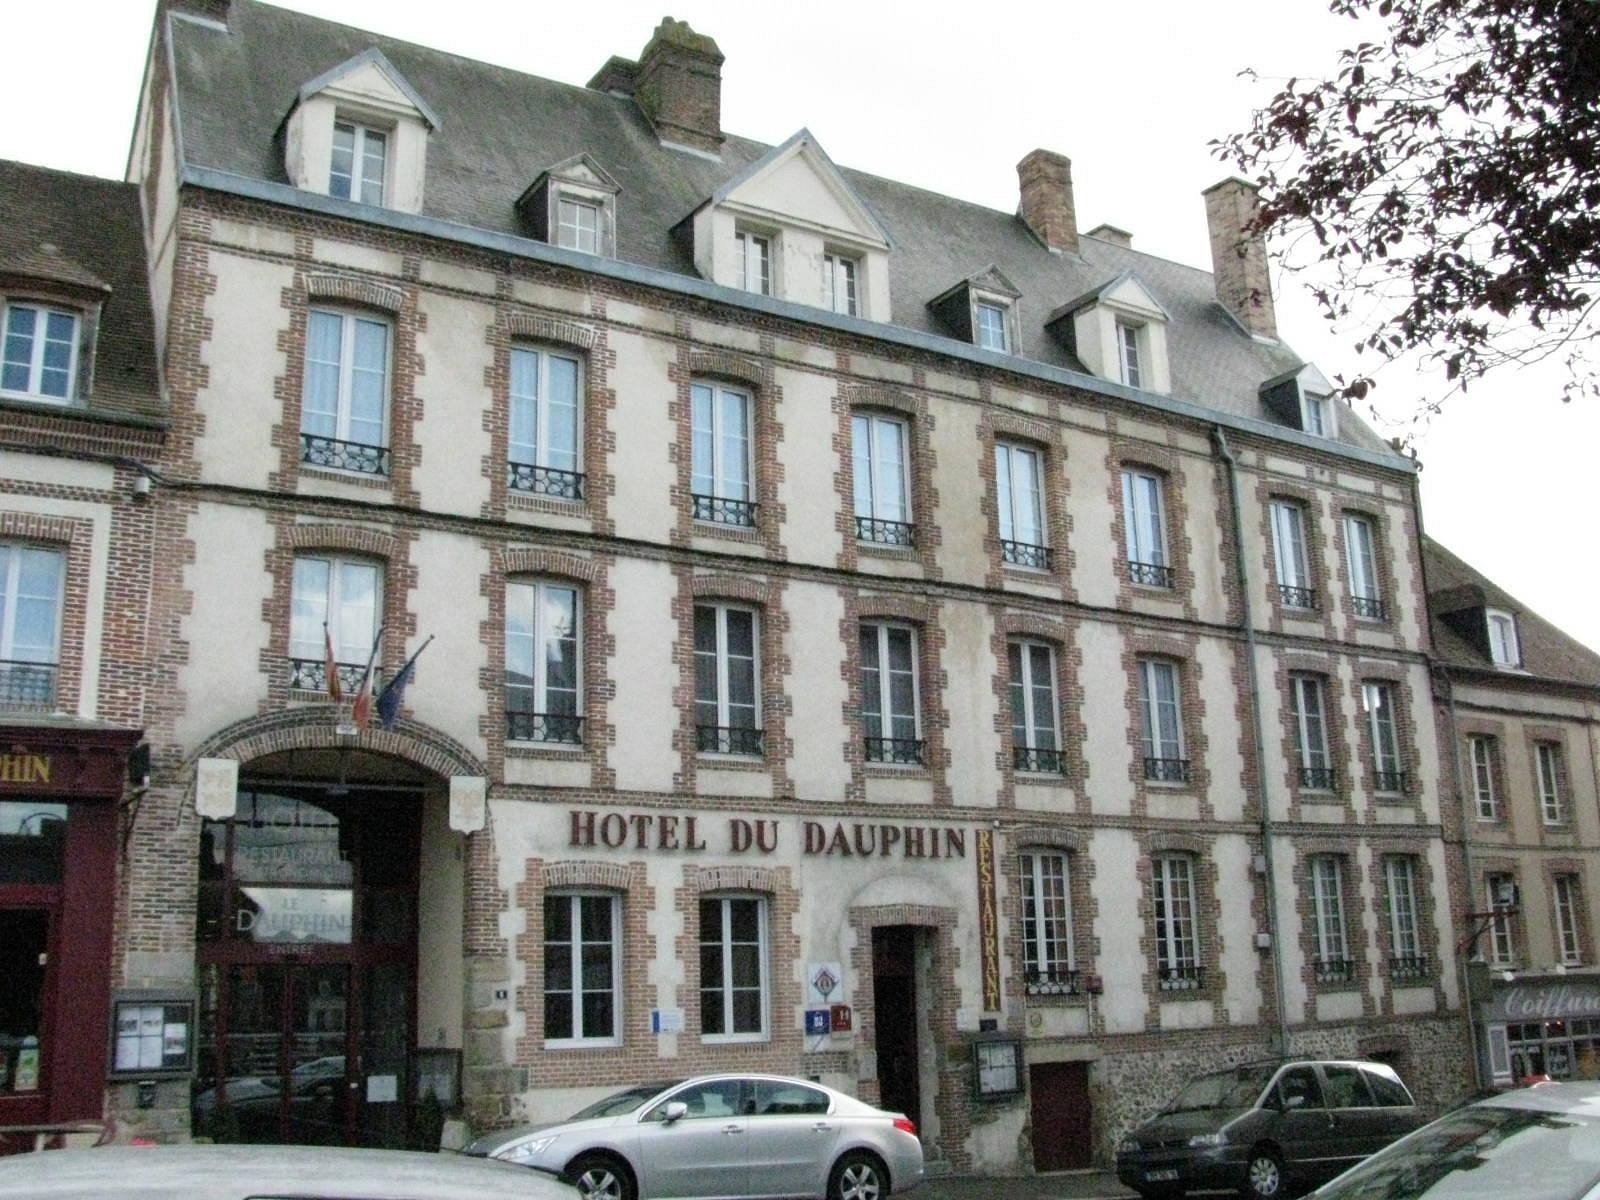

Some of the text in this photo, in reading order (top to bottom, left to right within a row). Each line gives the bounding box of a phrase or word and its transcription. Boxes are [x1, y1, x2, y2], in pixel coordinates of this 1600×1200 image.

[0, 754, 50, 782] HIN
[568, 811, 966, 857] HOTEL DU DAUPHIN
[281, 898, 299, 911] LE
[237, 909, 346, 933] DAUPHIN
[979, 830, 997, 1010] RESTAURANT
